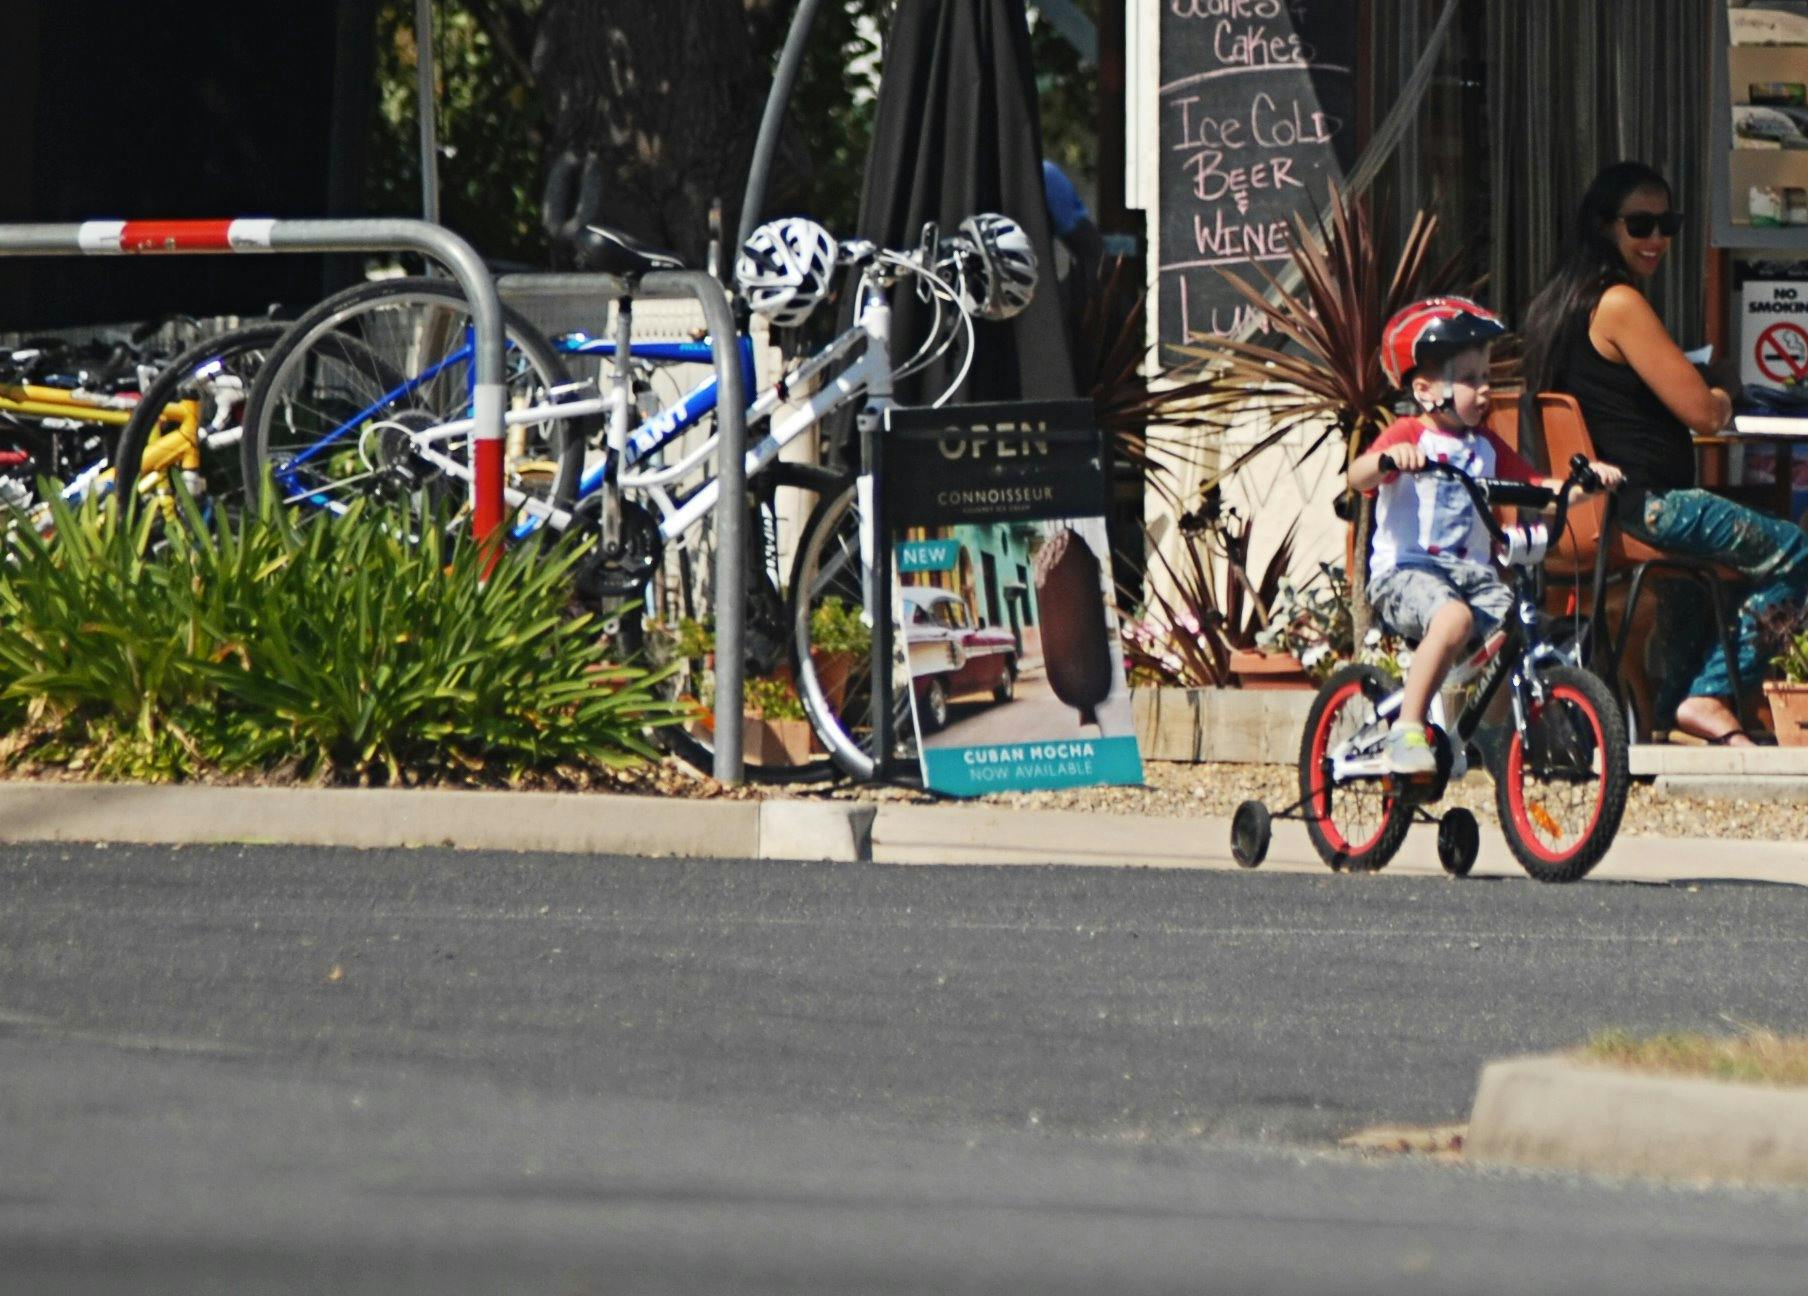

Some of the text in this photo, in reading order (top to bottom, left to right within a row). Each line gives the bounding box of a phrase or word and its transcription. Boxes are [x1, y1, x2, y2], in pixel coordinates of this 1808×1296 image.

[1169, 95, 1246, 151] Ice
[1193, 208, 1290, 256] WINE
[1773, 288, 1798, 300] NO
[938, 421, 1048, 460] OPEN
[937, 486, 1054, 506] CONNOISSEUR
[903, 547, 946, 565] NEW
[963, 742, 1095, 765] CUBAN MOCHA
[969, 760, 1093, 782] NOW AVAILABLE
